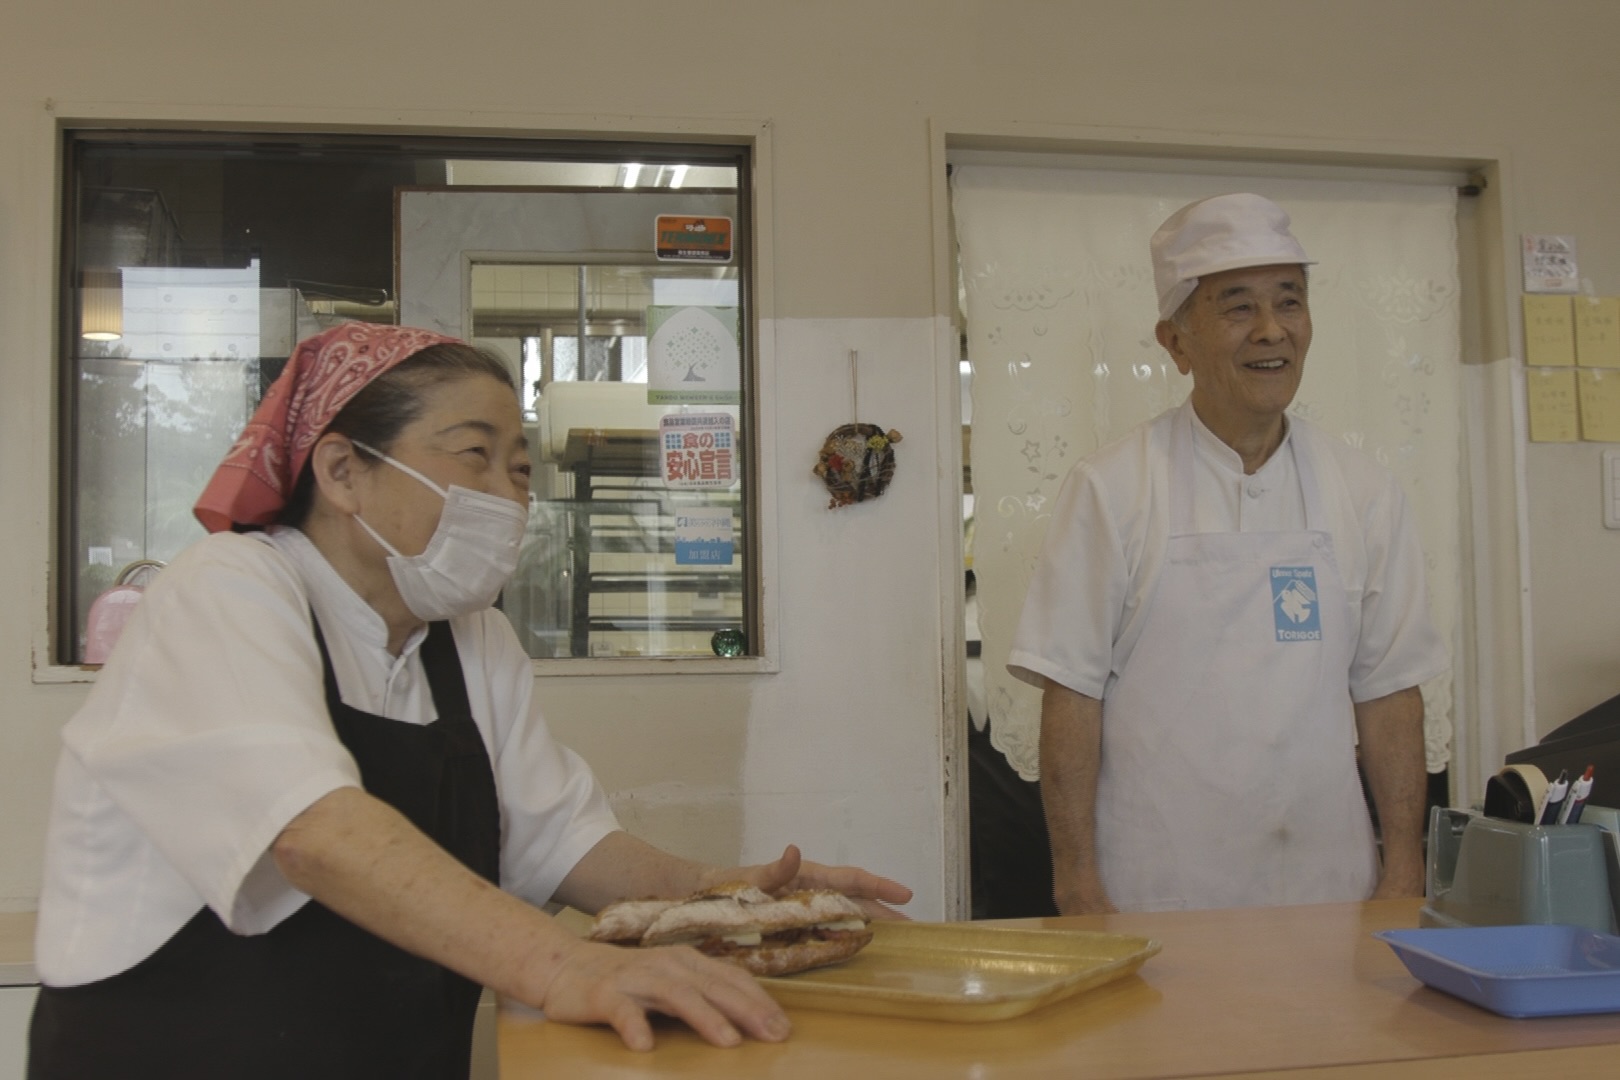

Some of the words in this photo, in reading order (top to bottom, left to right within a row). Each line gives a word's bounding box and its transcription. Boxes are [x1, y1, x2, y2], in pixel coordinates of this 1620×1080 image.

[682, 432, 714, 449] 食の
[666, 449, 732, 481] 安心宣言
[1277, 629, 1321, 640] TORIGOE
